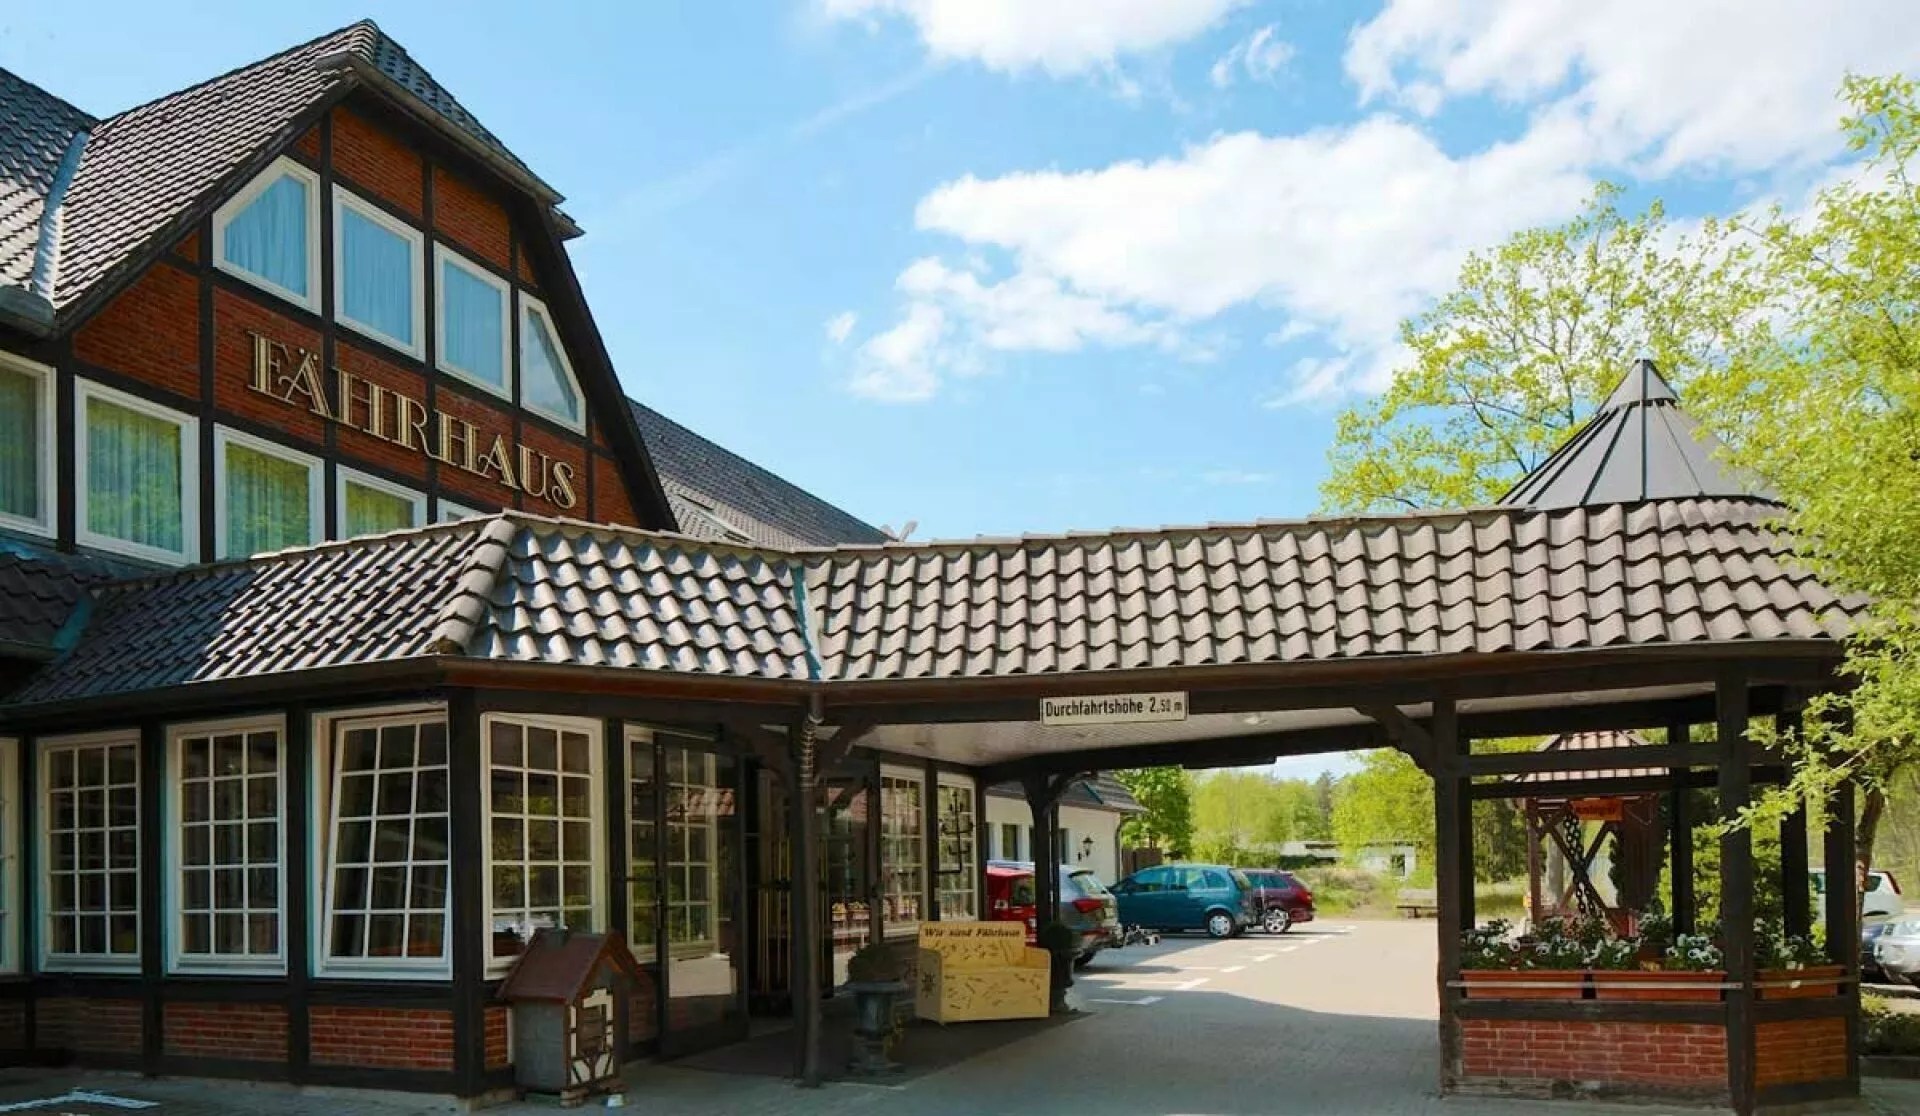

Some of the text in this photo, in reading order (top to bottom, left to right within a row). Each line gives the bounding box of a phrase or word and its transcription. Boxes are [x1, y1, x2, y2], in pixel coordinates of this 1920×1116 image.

[248, 331, 577, 509] FÄHRHAUS
[1045, 698, 1143, 717] Durchfahrtshöhe
[1174, 701, 1183, 712] m
[925, 928, 943, 937] Wir
